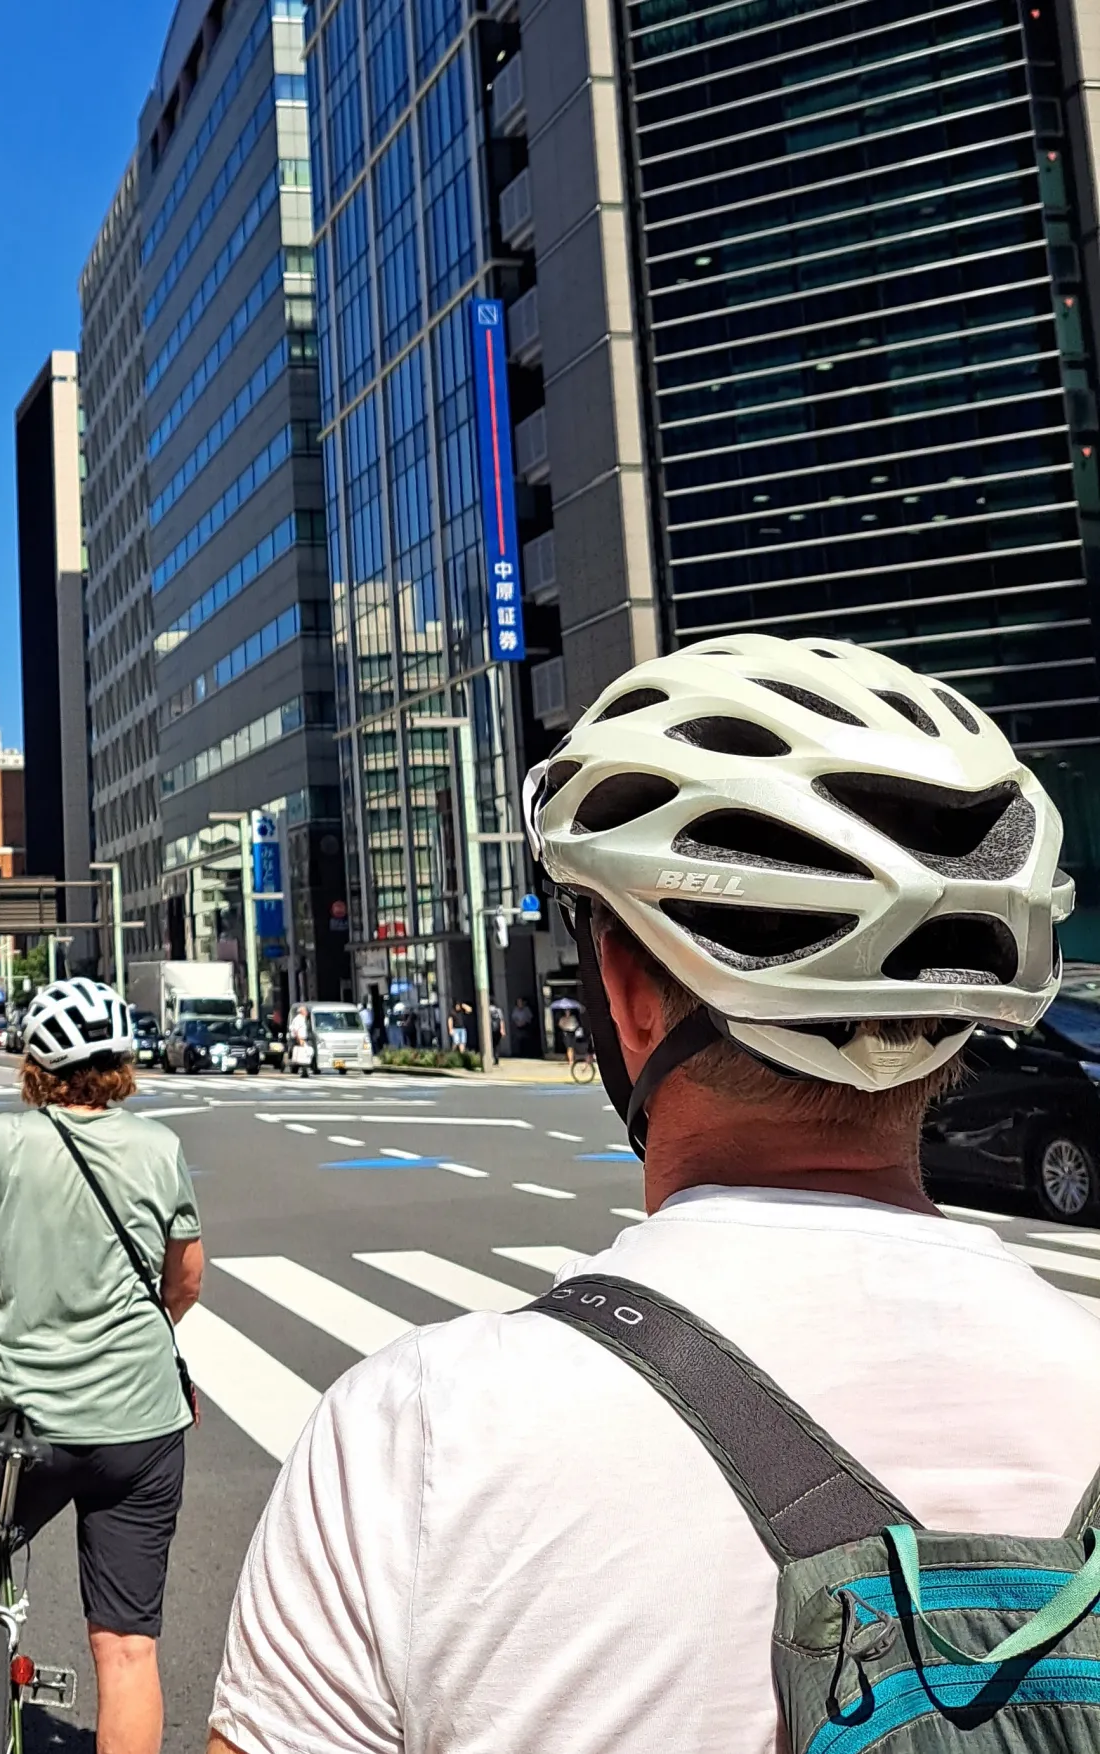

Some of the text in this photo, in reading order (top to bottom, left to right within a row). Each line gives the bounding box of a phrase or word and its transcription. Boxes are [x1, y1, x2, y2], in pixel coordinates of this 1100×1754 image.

[494, 560, 518, 651] 中原証券
[655, 870, 745, 896] BELL
